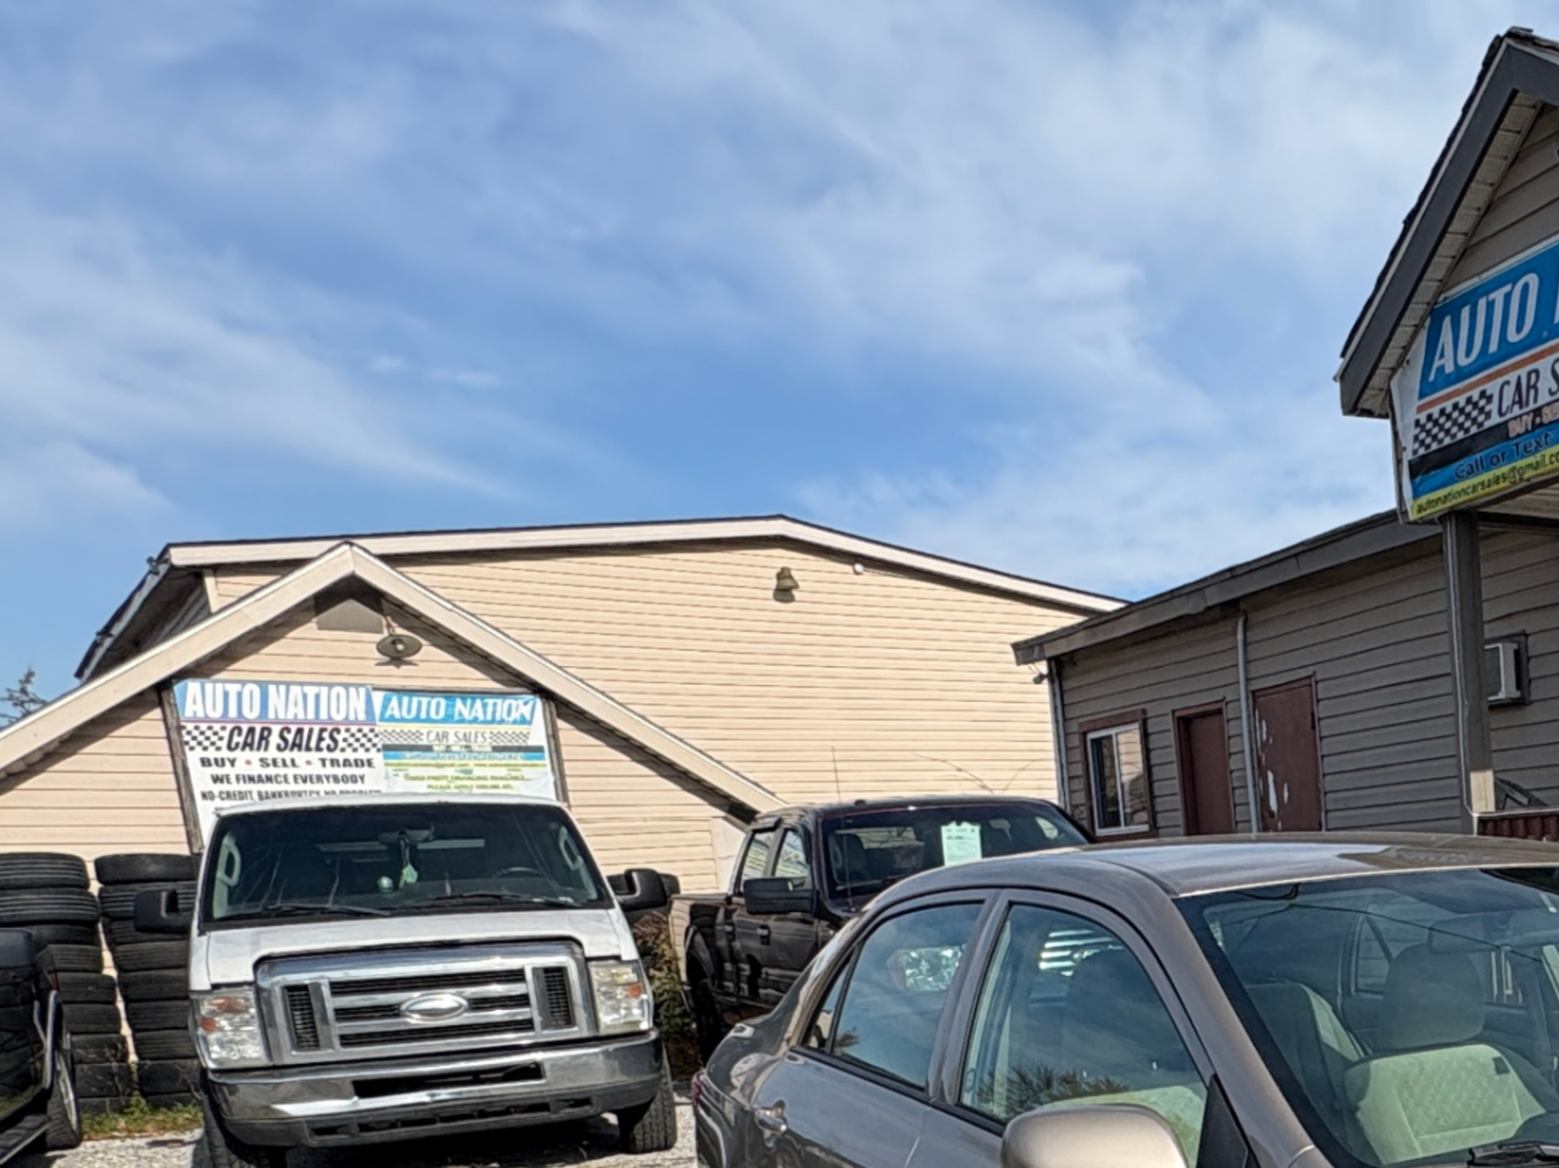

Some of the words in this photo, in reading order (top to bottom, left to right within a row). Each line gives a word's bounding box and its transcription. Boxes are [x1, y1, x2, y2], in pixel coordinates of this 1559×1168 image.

[1429, 271, 1539, 383] AUTO
[1497, 369, 1540, 418] CAR
[1508, 411, 1536, 438] BUY
[1455, 456, 1485, 480] Call
[1490, 452, 1510, 467] or
[184, 682, 260, 720] AUTO
[267, 684, 366, 721] NATION
[384, 695, 446, 720] AUTO
[454, 697, 534, 722] NATION
[227, 725, 272, 752] CAR
[276, 726, 341, 753] SALES
[426, 731, 449, 743] CAR
[454, 730, 488, 744] SALES
[200, 757, 237, 768] BUY
[259, 757, 300, 769] SELL
[318, 757, 376, 769] TRADE
[210, 774, 232, 785] WE
[236, 773, 290, 785] FINANCE
[294, 773, 366, 785] EVERYBODY
